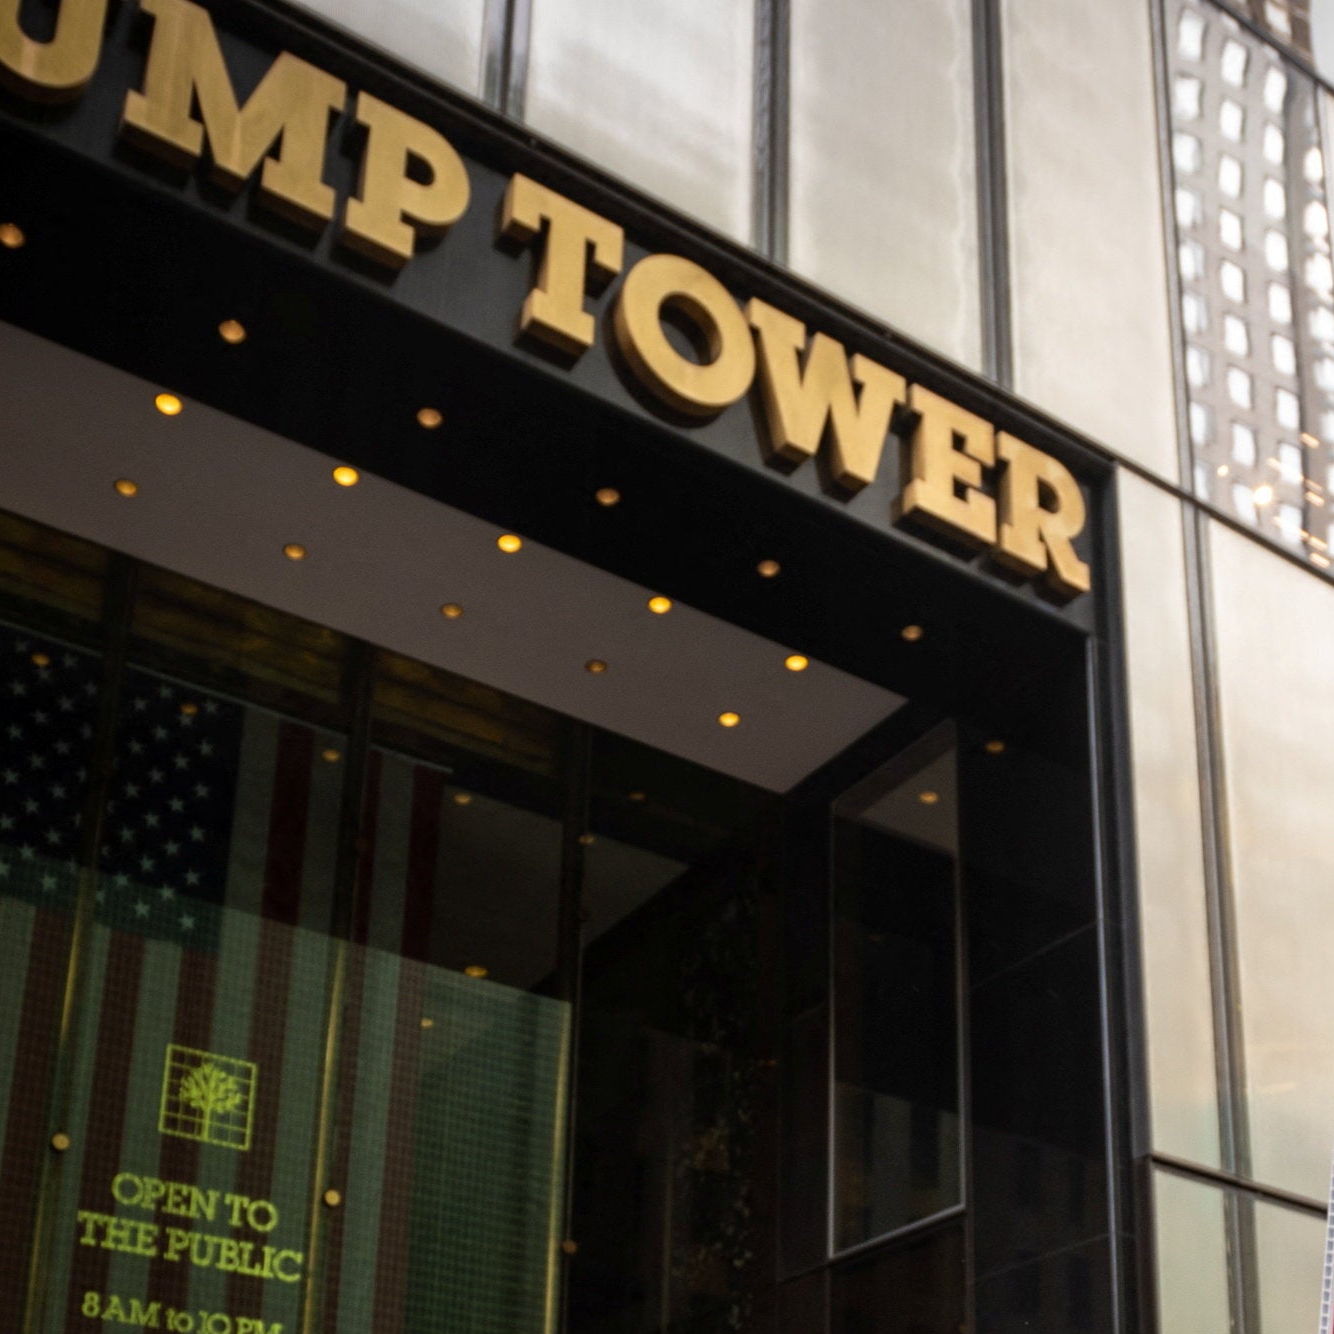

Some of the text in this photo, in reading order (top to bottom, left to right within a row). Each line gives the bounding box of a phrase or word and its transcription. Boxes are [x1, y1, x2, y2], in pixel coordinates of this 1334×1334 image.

[502, 172, 1091, 594] TOWER
[111, 1171, 279, 1233] OPEN TO
[77, 1209, 304, 1283] THE PUBLIC
[166, 1308, 194, 1334] to
